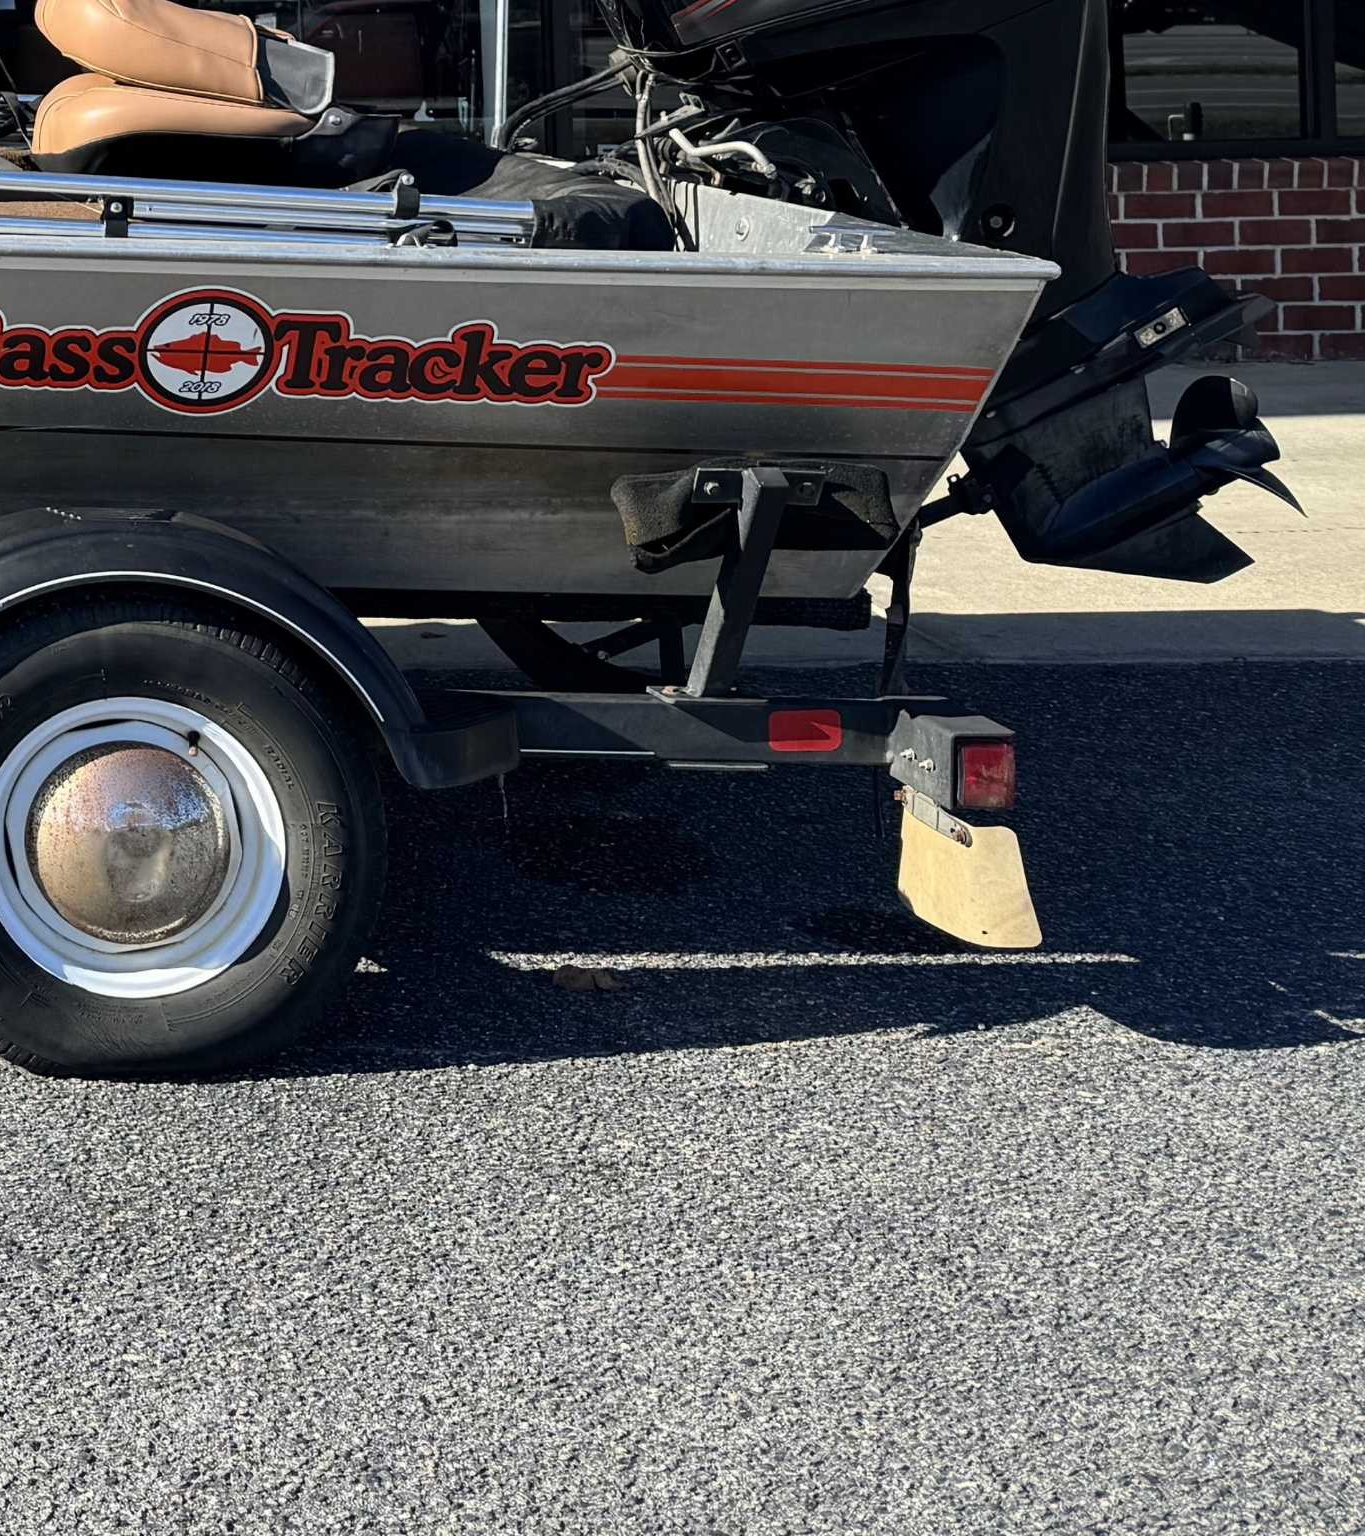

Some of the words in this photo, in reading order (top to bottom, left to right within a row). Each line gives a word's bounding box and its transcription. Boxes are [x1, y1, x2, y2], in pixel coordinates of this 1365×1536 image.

[189, 313, 230, 326] 1978
[275, 320, 604, 399] Tracker
[179, 381, 221, 393] 2018
[278, 800, 344, 987] KARRIER
